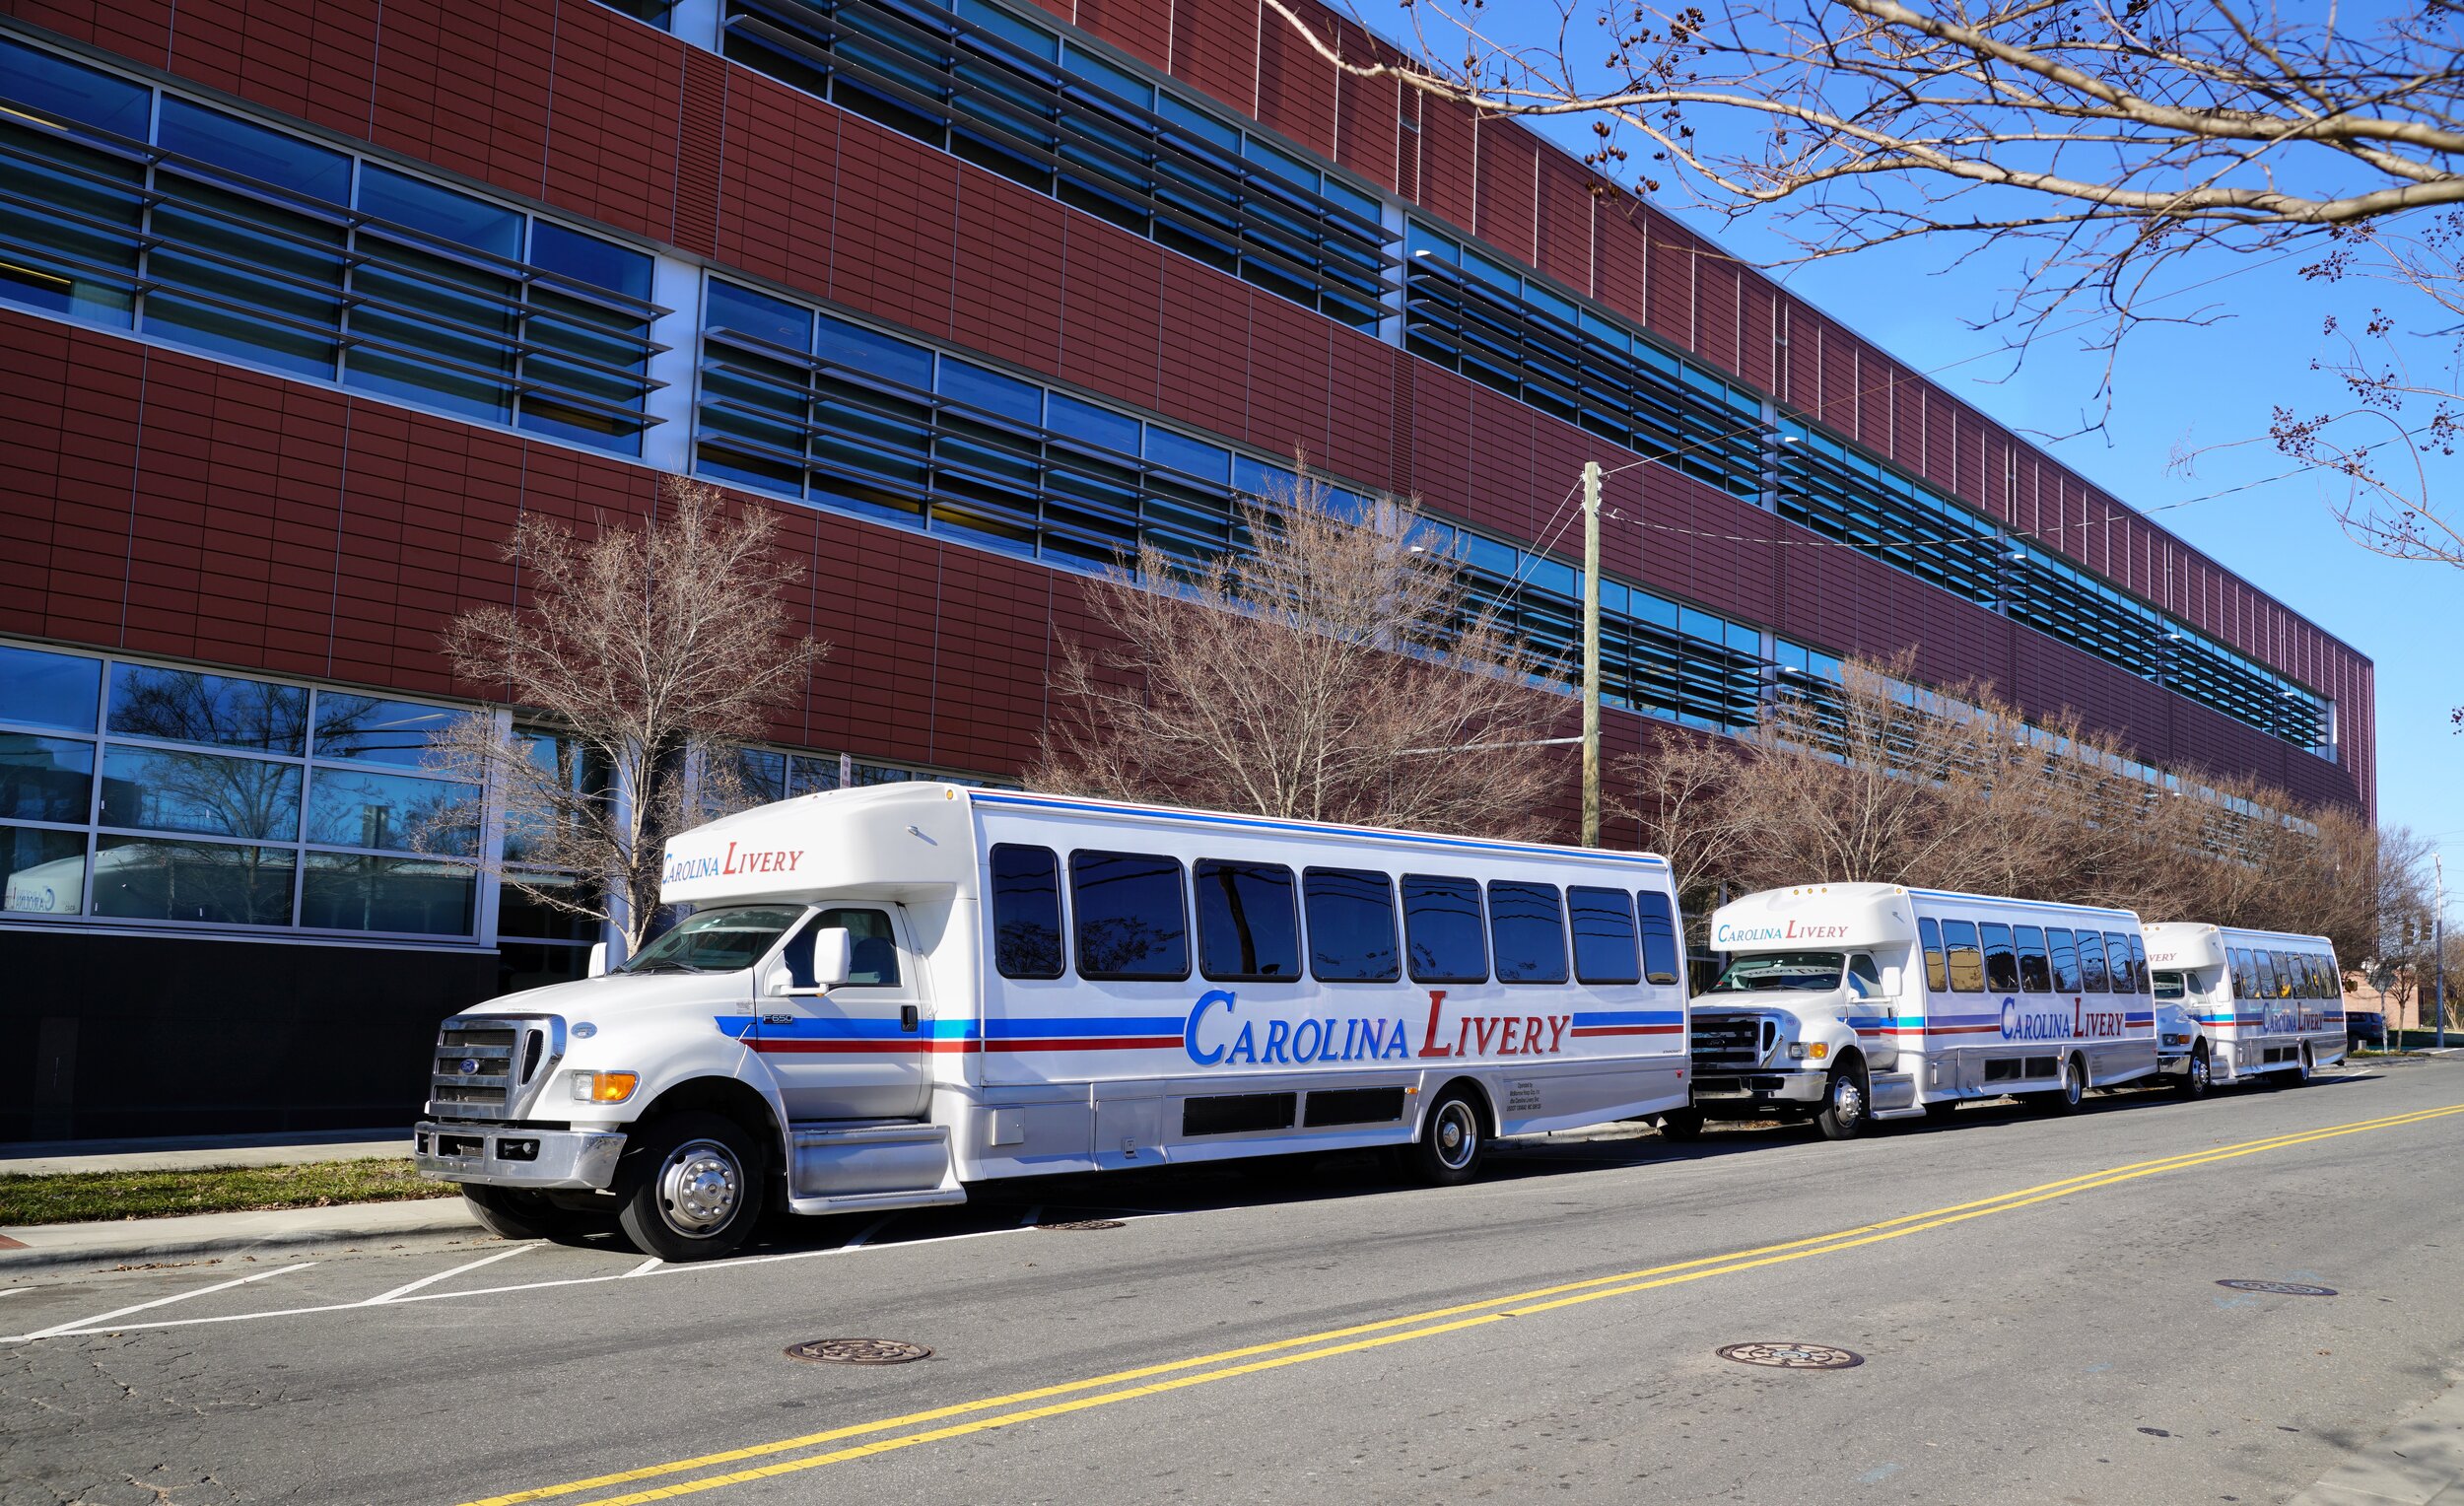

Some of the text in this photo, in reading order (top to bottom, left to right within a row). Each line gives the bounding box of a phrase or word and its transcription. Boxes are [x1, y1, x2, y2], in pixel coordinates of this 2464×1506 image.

[662, 842, 804, 885] CAROLINA LIVERY
[1718, 920, 1849, 943] CAROLINA LIVERY
[2148, 952, 2177, 963] VERY
[1185, 990, 1571, 1067] CAROLINA LIVERY
[2001, 996, 2124, 1041] CAROLINA LIVERY
[2262, 1001, 2324, 1034] CAROLINA LIVERY
